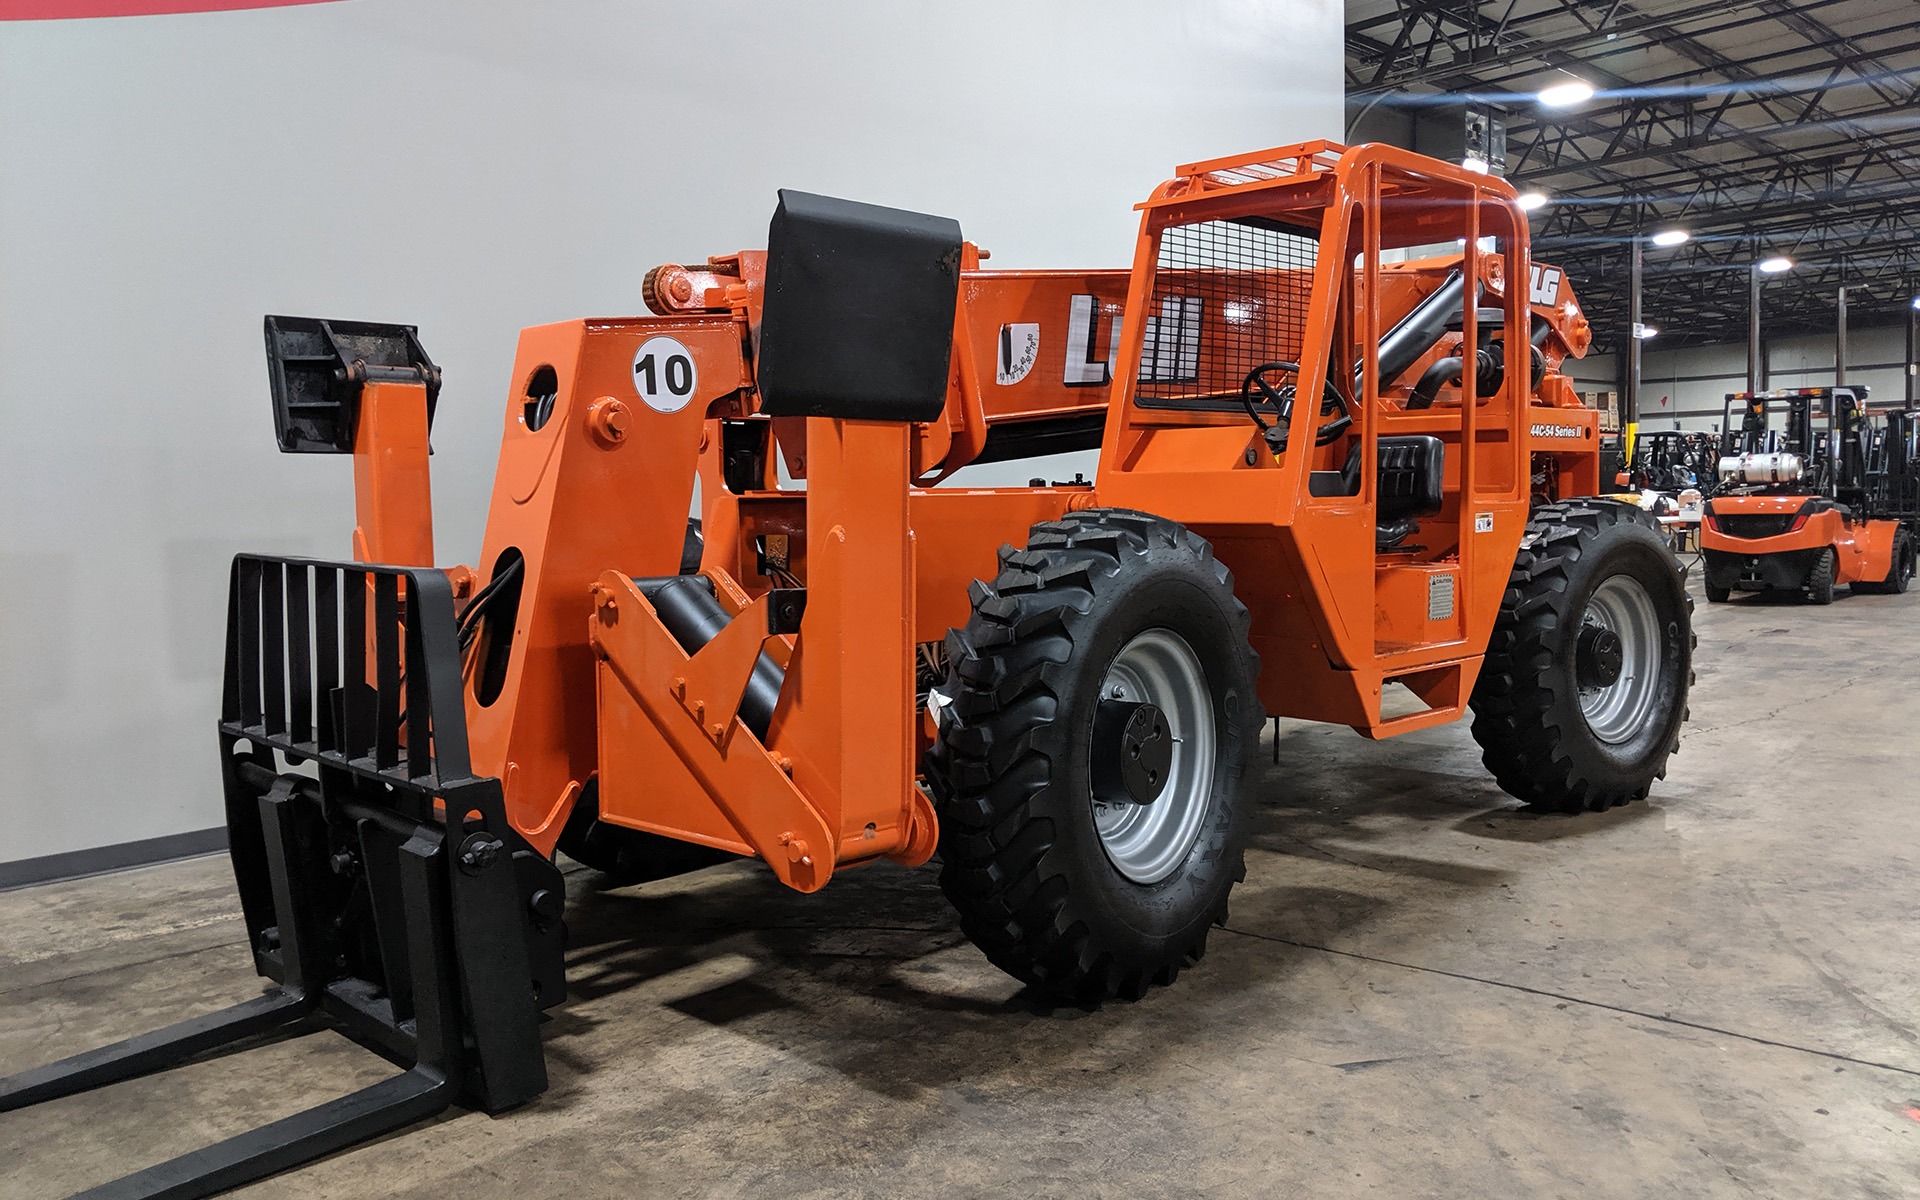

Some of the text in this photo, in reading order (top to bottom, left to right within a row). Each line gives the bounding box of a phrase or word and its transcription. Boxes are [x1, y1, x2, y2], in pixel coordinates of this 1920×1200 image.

[1530, 265, 1561, 306] LG
[635, 354, 693, 396] 10
[1530, 423, 1554, 438] 44C-54
[1554, 424, 1576, 438] Series
